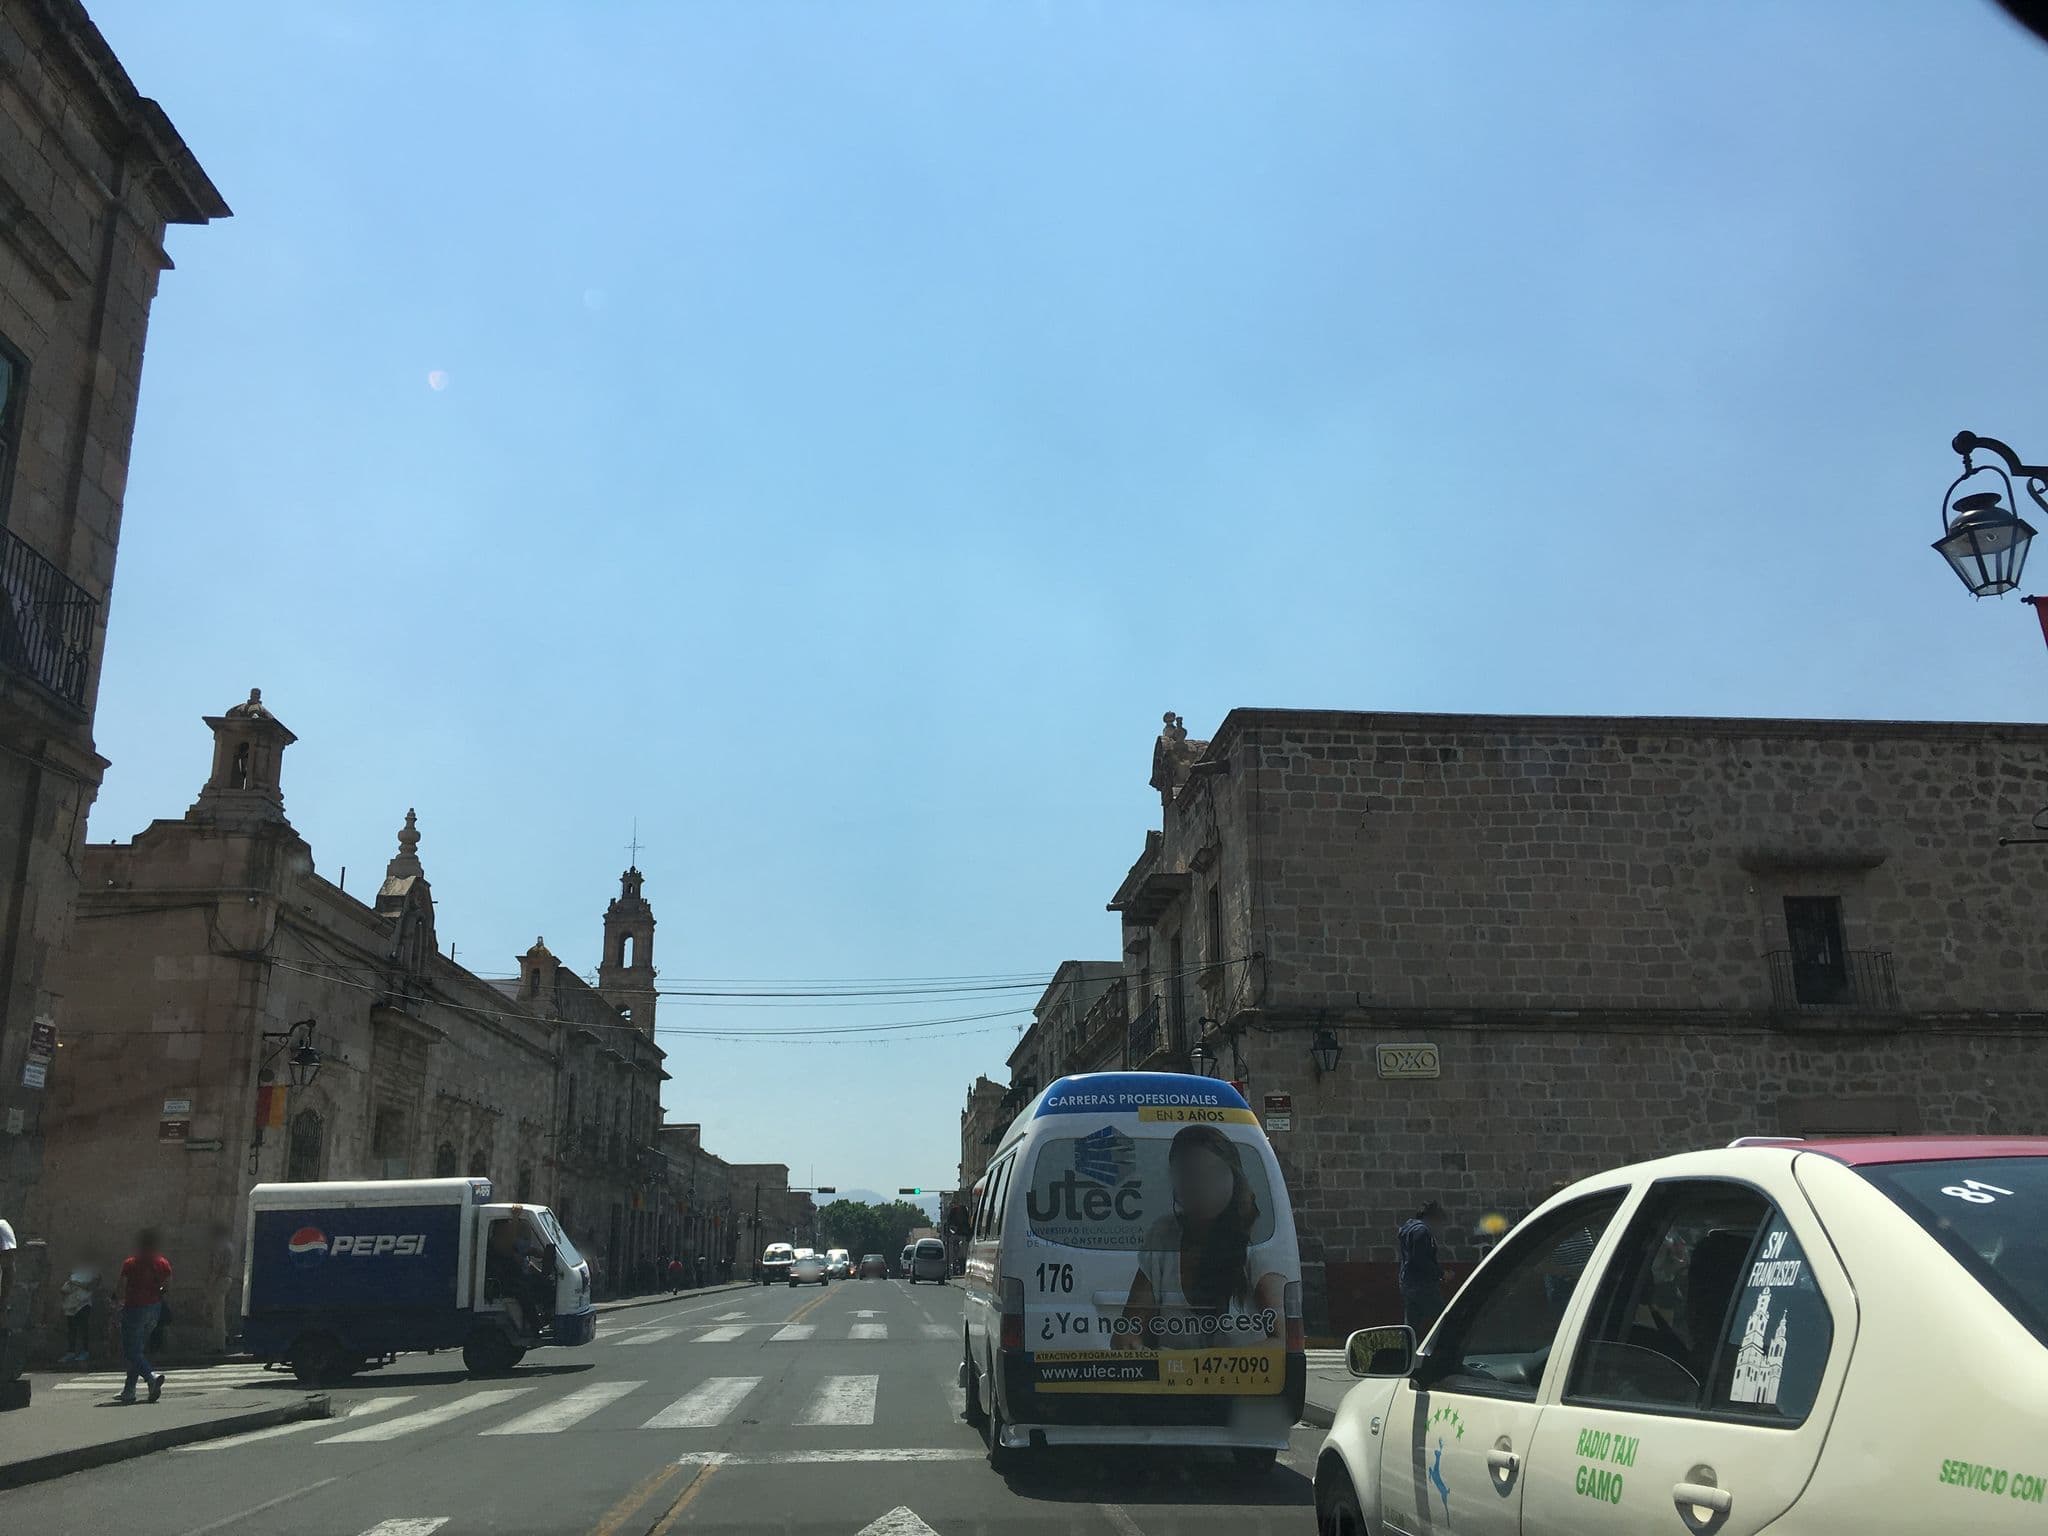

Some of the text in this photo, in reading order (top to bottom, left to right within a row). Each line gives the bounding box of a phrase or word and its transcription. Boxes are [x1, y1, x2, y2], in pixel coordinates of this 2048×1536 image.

[1383, 1051, 1437, 1070] OXXO
[1047, 1093, 1218, 1107] CARRERAS PROFESIONALES
[1156, 1108, 1225, 1121] EN 3 AÑOS
[1940, 1178, 2016, 1205] 81
[330, 1234, 427, 1256] PEPSI
[1762, 1231, 1788, 1259] SN
[1036, 1262, 1074, 1293] 176
[1747, 1260, 1801, 1288] FRANCISCO
[1098, 1315, 1142, 1335] nos
[1149, 1308, 1278, 1337] conoces?
[1035, 1351, 1077, 1360] ATRACTIVO
[1079, 1351, 1123, 1360] PROGRAMA
[1041, 1364, 1144, 1379] www.utec.mx
[1576, 1428, 1640, 1467] RADIO TAXI
[1575, 1465, 1623, 1504] GAMO
[1939, 1458, 2047, 1504] SERVICIO CON
